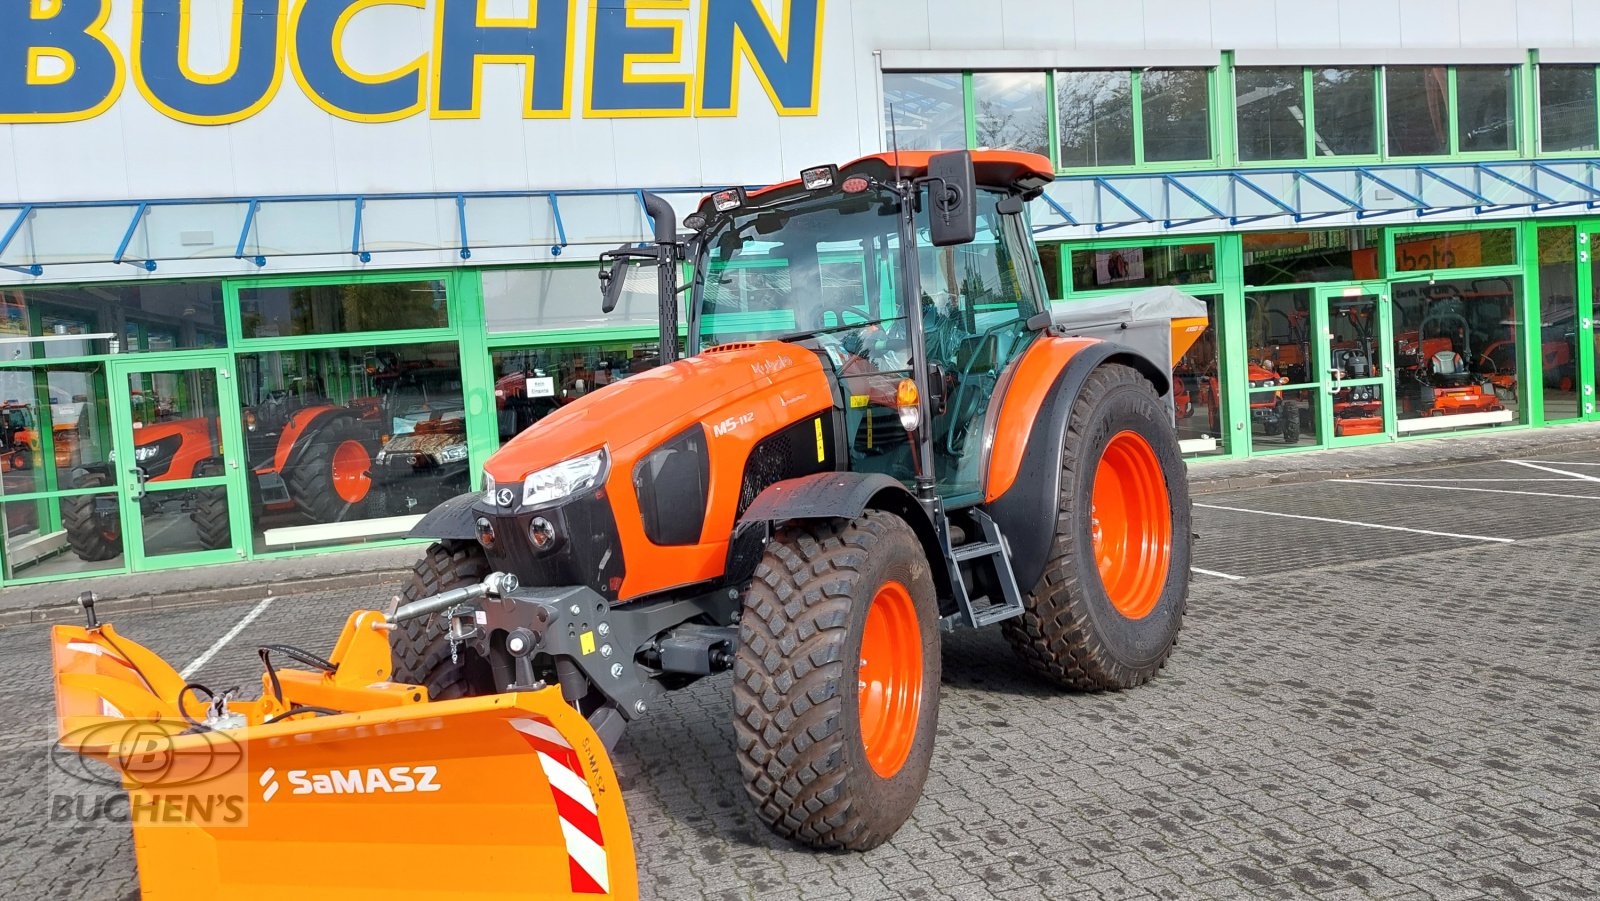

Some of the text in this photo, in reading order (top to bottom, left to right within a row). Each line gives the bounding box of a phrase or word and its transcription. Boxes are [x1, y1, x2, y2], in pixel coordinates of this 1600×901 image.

[0, 0, 823, 125] BUCHEN
[713, 412, 755, 438] M5-112
[287, 766, 442, 795] SaMASZ
